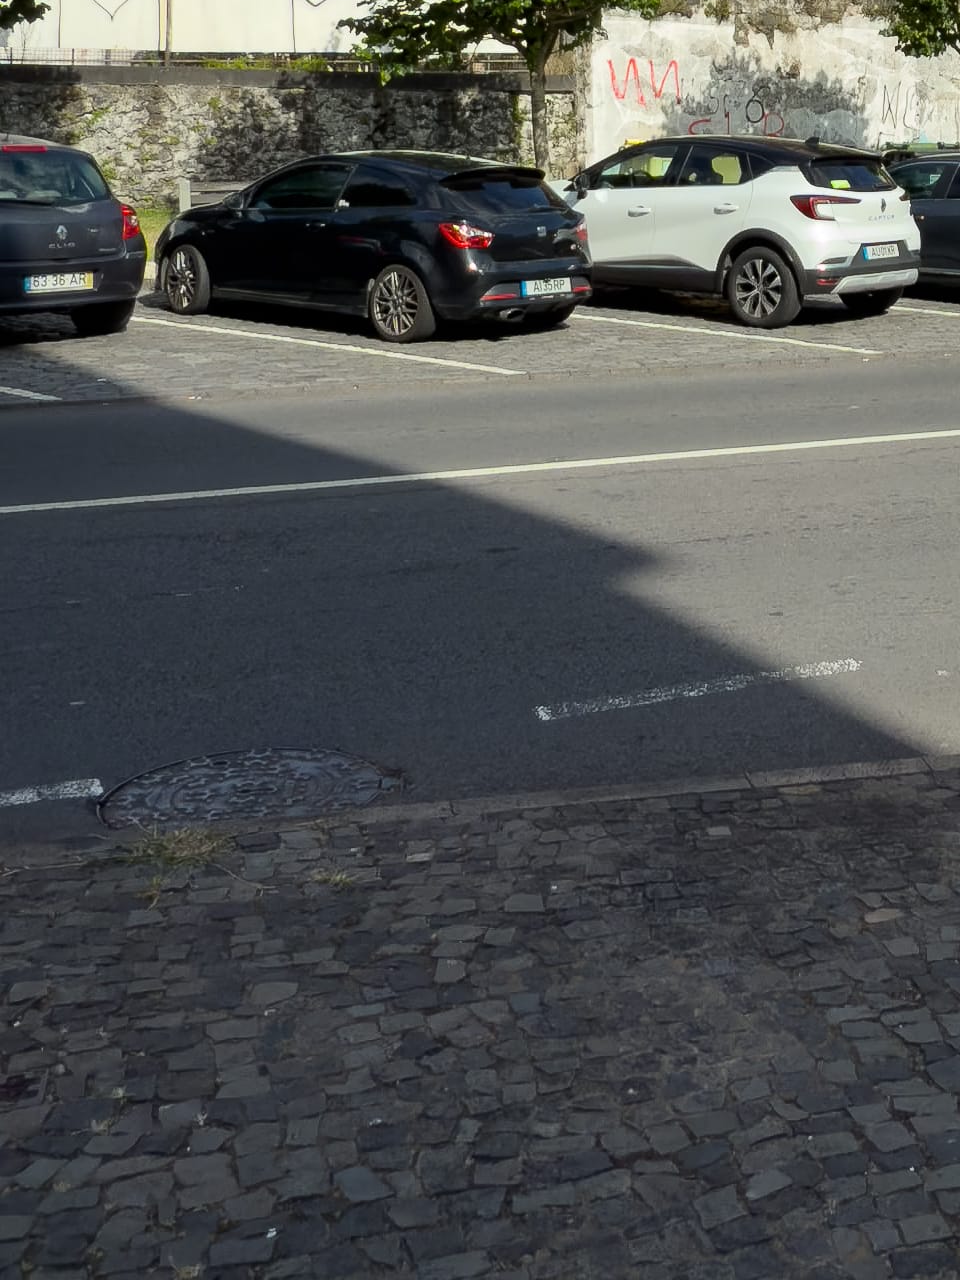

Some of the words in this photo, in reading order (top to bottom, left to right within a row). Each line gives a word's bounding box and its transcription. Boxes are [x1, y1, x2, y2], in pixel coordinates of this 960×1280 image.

[33, 274, 48, 288] 63
[52, 273, 66, 287] 36
[69, 271, 87, 286] AR
